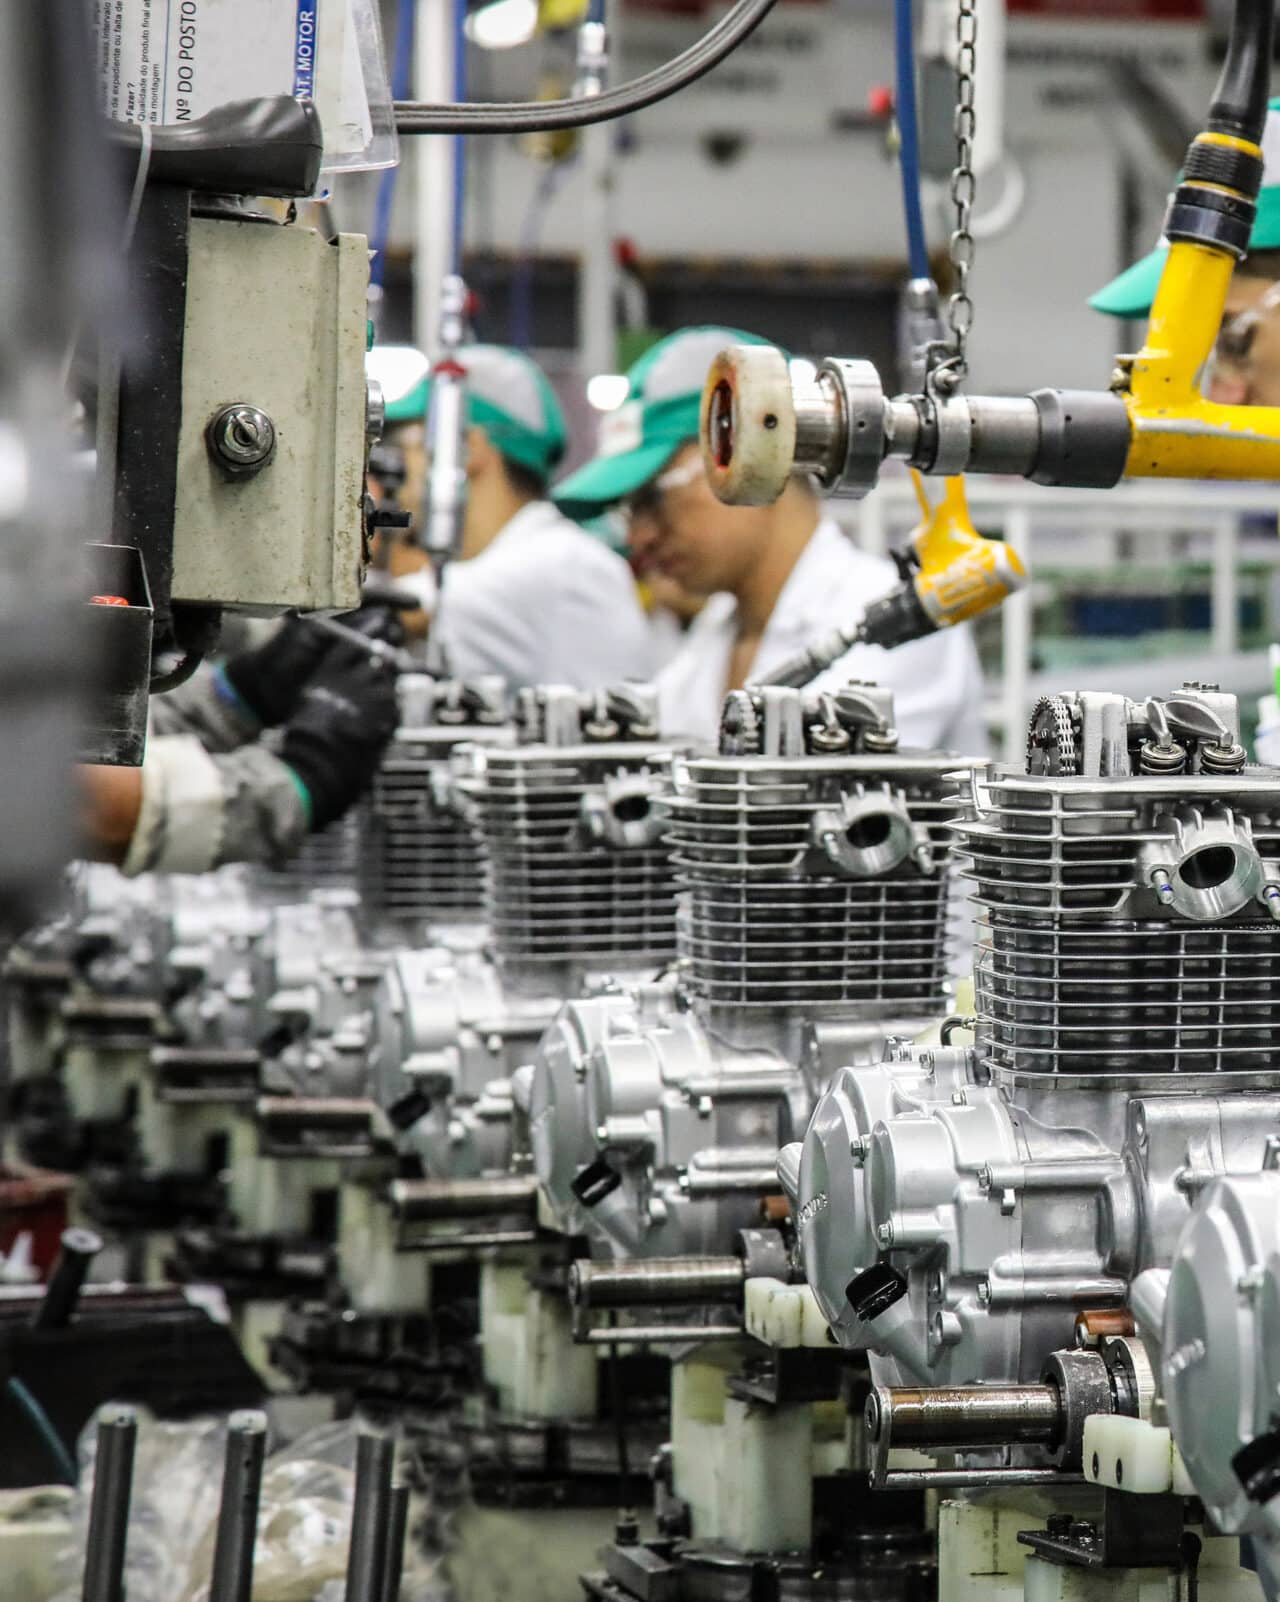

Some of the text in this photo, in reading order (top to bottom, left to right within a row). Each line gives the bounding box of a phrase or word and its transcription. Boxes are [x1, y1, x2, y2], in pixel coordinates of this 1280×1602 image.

[115, 1, 123, 12] de
[141, 9, 151, 28] final
[113, 14, 122, 32] falta
[114, 35, 121, 46] ou
[141, 29, 150, 63] produto
[296, 10, 314, 71] MOTOR
[112, 47, 121, 95] expediente
[140, 65, 148, 76] do
[176, 1, 197, 121] Nº DO POSTO
[126, 91, 135, 116] Fazer
[137, 78, 147, 121] Qualidade
[149, 64, 160, 122] da montagem
